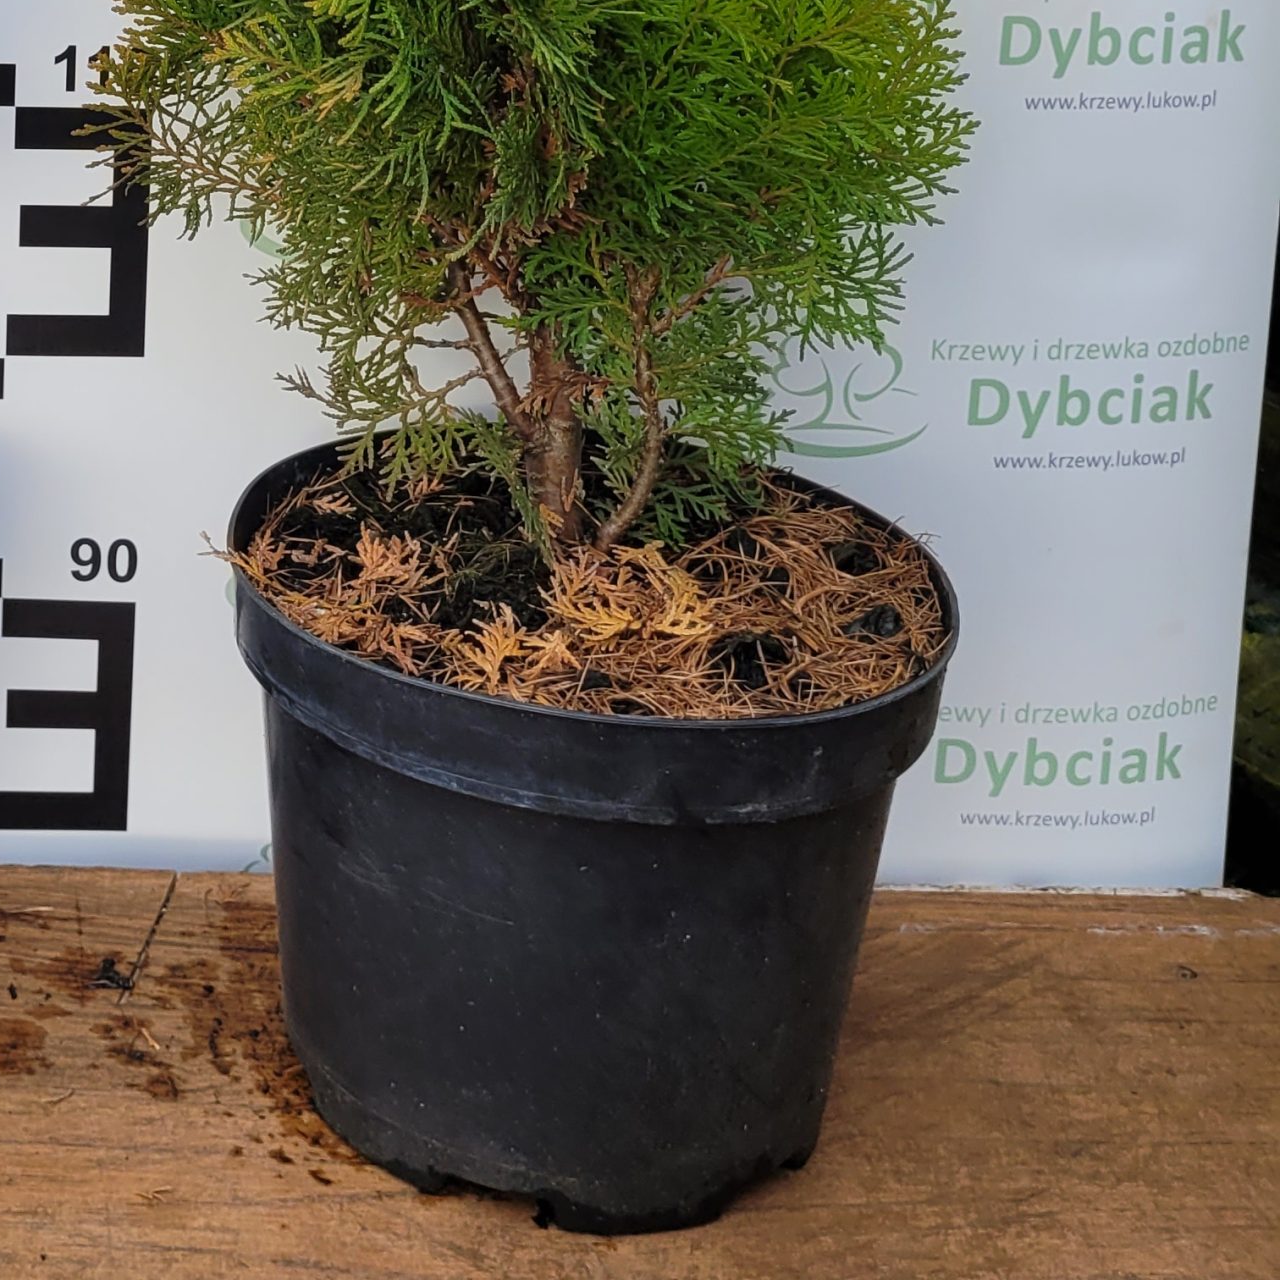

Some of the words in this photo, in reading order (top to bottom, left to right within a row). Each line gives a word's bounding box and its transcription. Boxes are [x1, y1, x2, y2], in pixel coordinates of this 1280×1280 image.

[998, 8, 1247, 80] Dybciak
[53, 44, 132, 93] 11
[1024, 89, 1217, 113] www.krzewy.lukow.pl
[931, 338, 1025, 367] Krzewy
[1032, 338, 1039, 361] i
[1046, 335, 1149, 361] drzewka
[1157, 331, 1251, 358] ozdobne
[967, 369, 1214, 440] Dybciak
[993, 446, 1186, 472] www.krzewy.lukow.pl
[70, 537, 138, 584] 90
[939, 705, 992, 729] ewy
[999, 701, 1006, 724] i
[1014, 701, 1119, 724] drzewka
[1126, 694, 1219, 722] ozdobne
[932, 731, 1183, 798] Dybciak
[960, 806, 1156, 830] www.krzewy.lukow.pl
